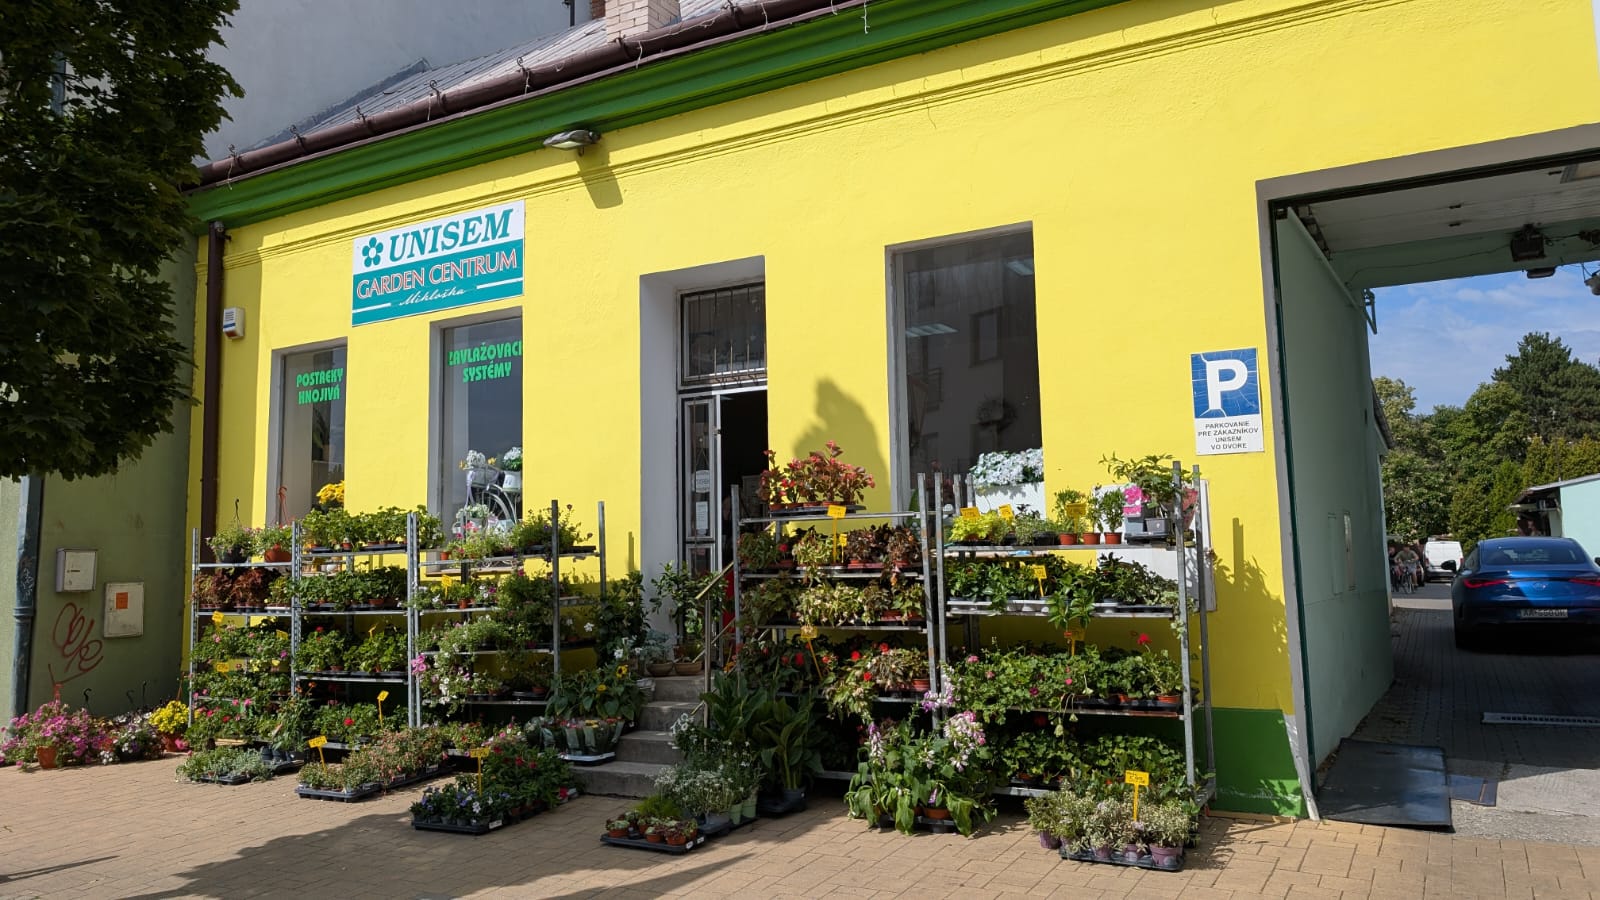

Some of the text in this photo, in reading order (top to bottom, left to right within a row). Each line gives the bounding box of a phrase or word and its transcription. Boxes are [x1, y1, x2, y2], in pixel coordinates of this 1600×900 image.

[389, 208, 513, 263] UNISEM
[356, 248, 518, 299] GARDEN CENTRUM
[296, 367, 344, 388] POSTREKY
[463, 360, 512, 383] SYSTÉMY
[298, 384, 340, 405] HNOJIVÁ
[1206, 359, 1248, 410] P
[1205, 421, 1250, 429] PARKOVANIE
